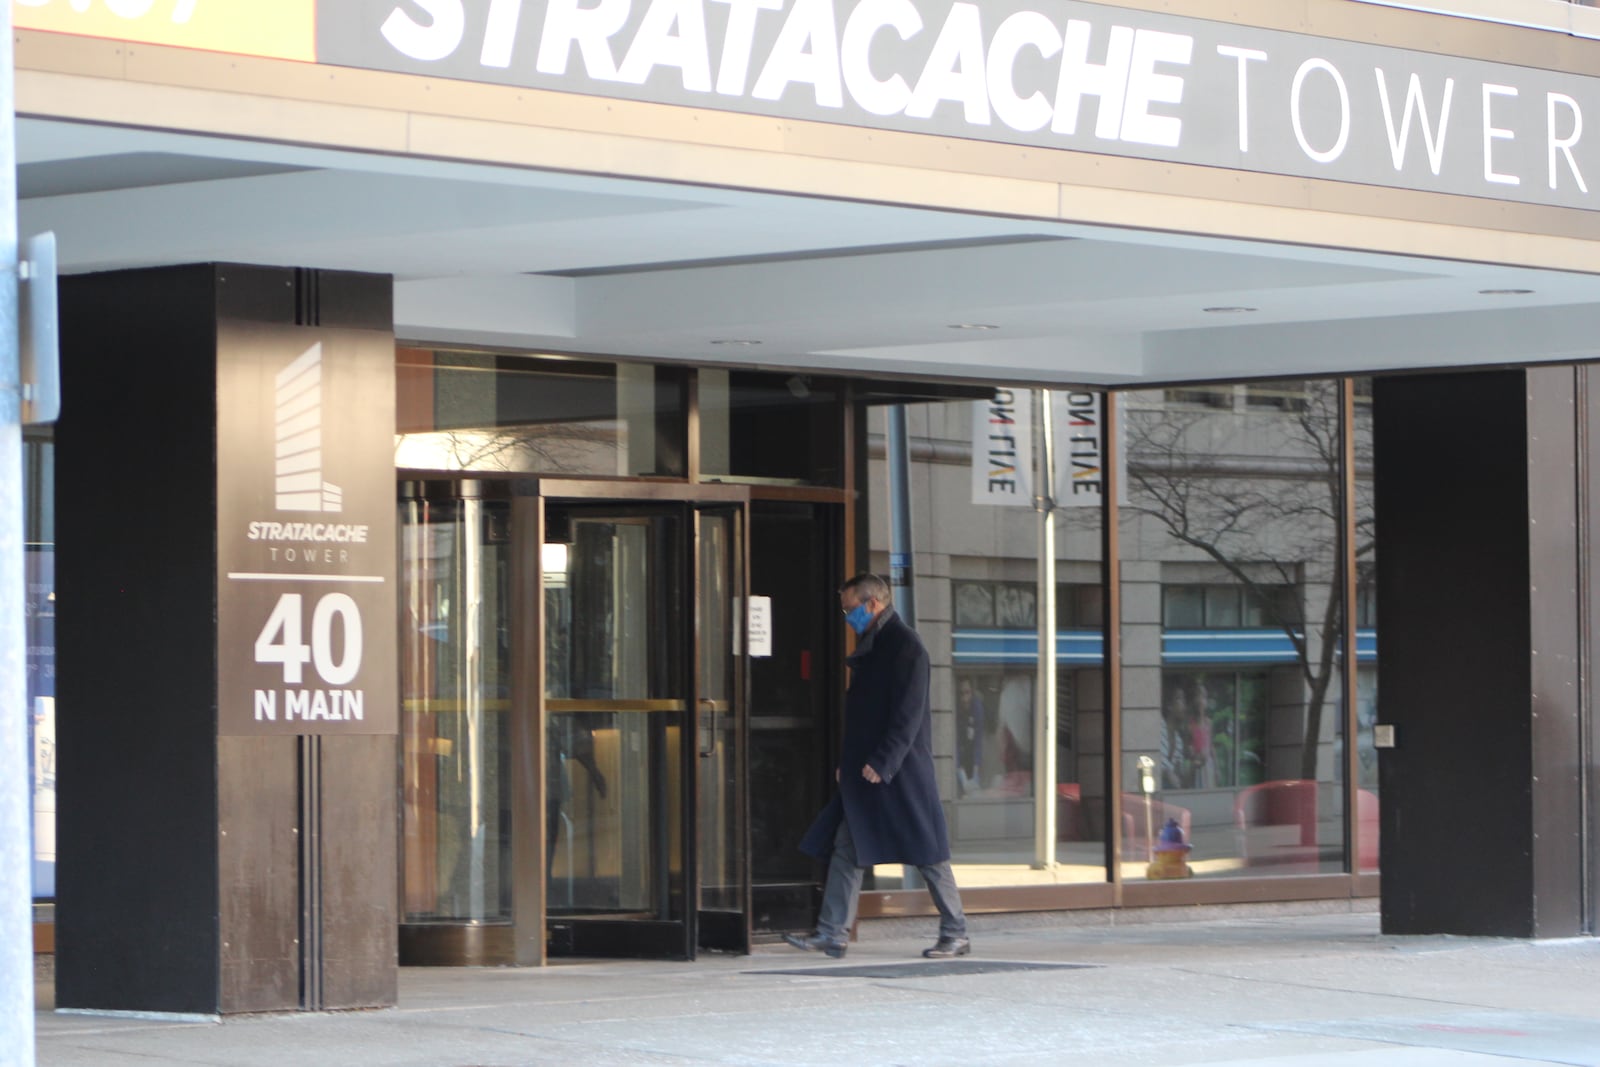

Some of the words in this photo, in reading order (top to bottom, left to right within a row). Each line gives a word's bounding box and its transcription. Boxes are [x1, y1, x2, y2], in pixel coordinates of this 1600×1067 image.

[1216, 43, 1588, 194] TOWER
[247, 521, 369, 543] STRATACACHE
[269, 547, 350, 564] TOWER
[254, 592, 363, 685] 40
[254, 689, 277, 720] N
[285, 689, 364, 721] MAIN
